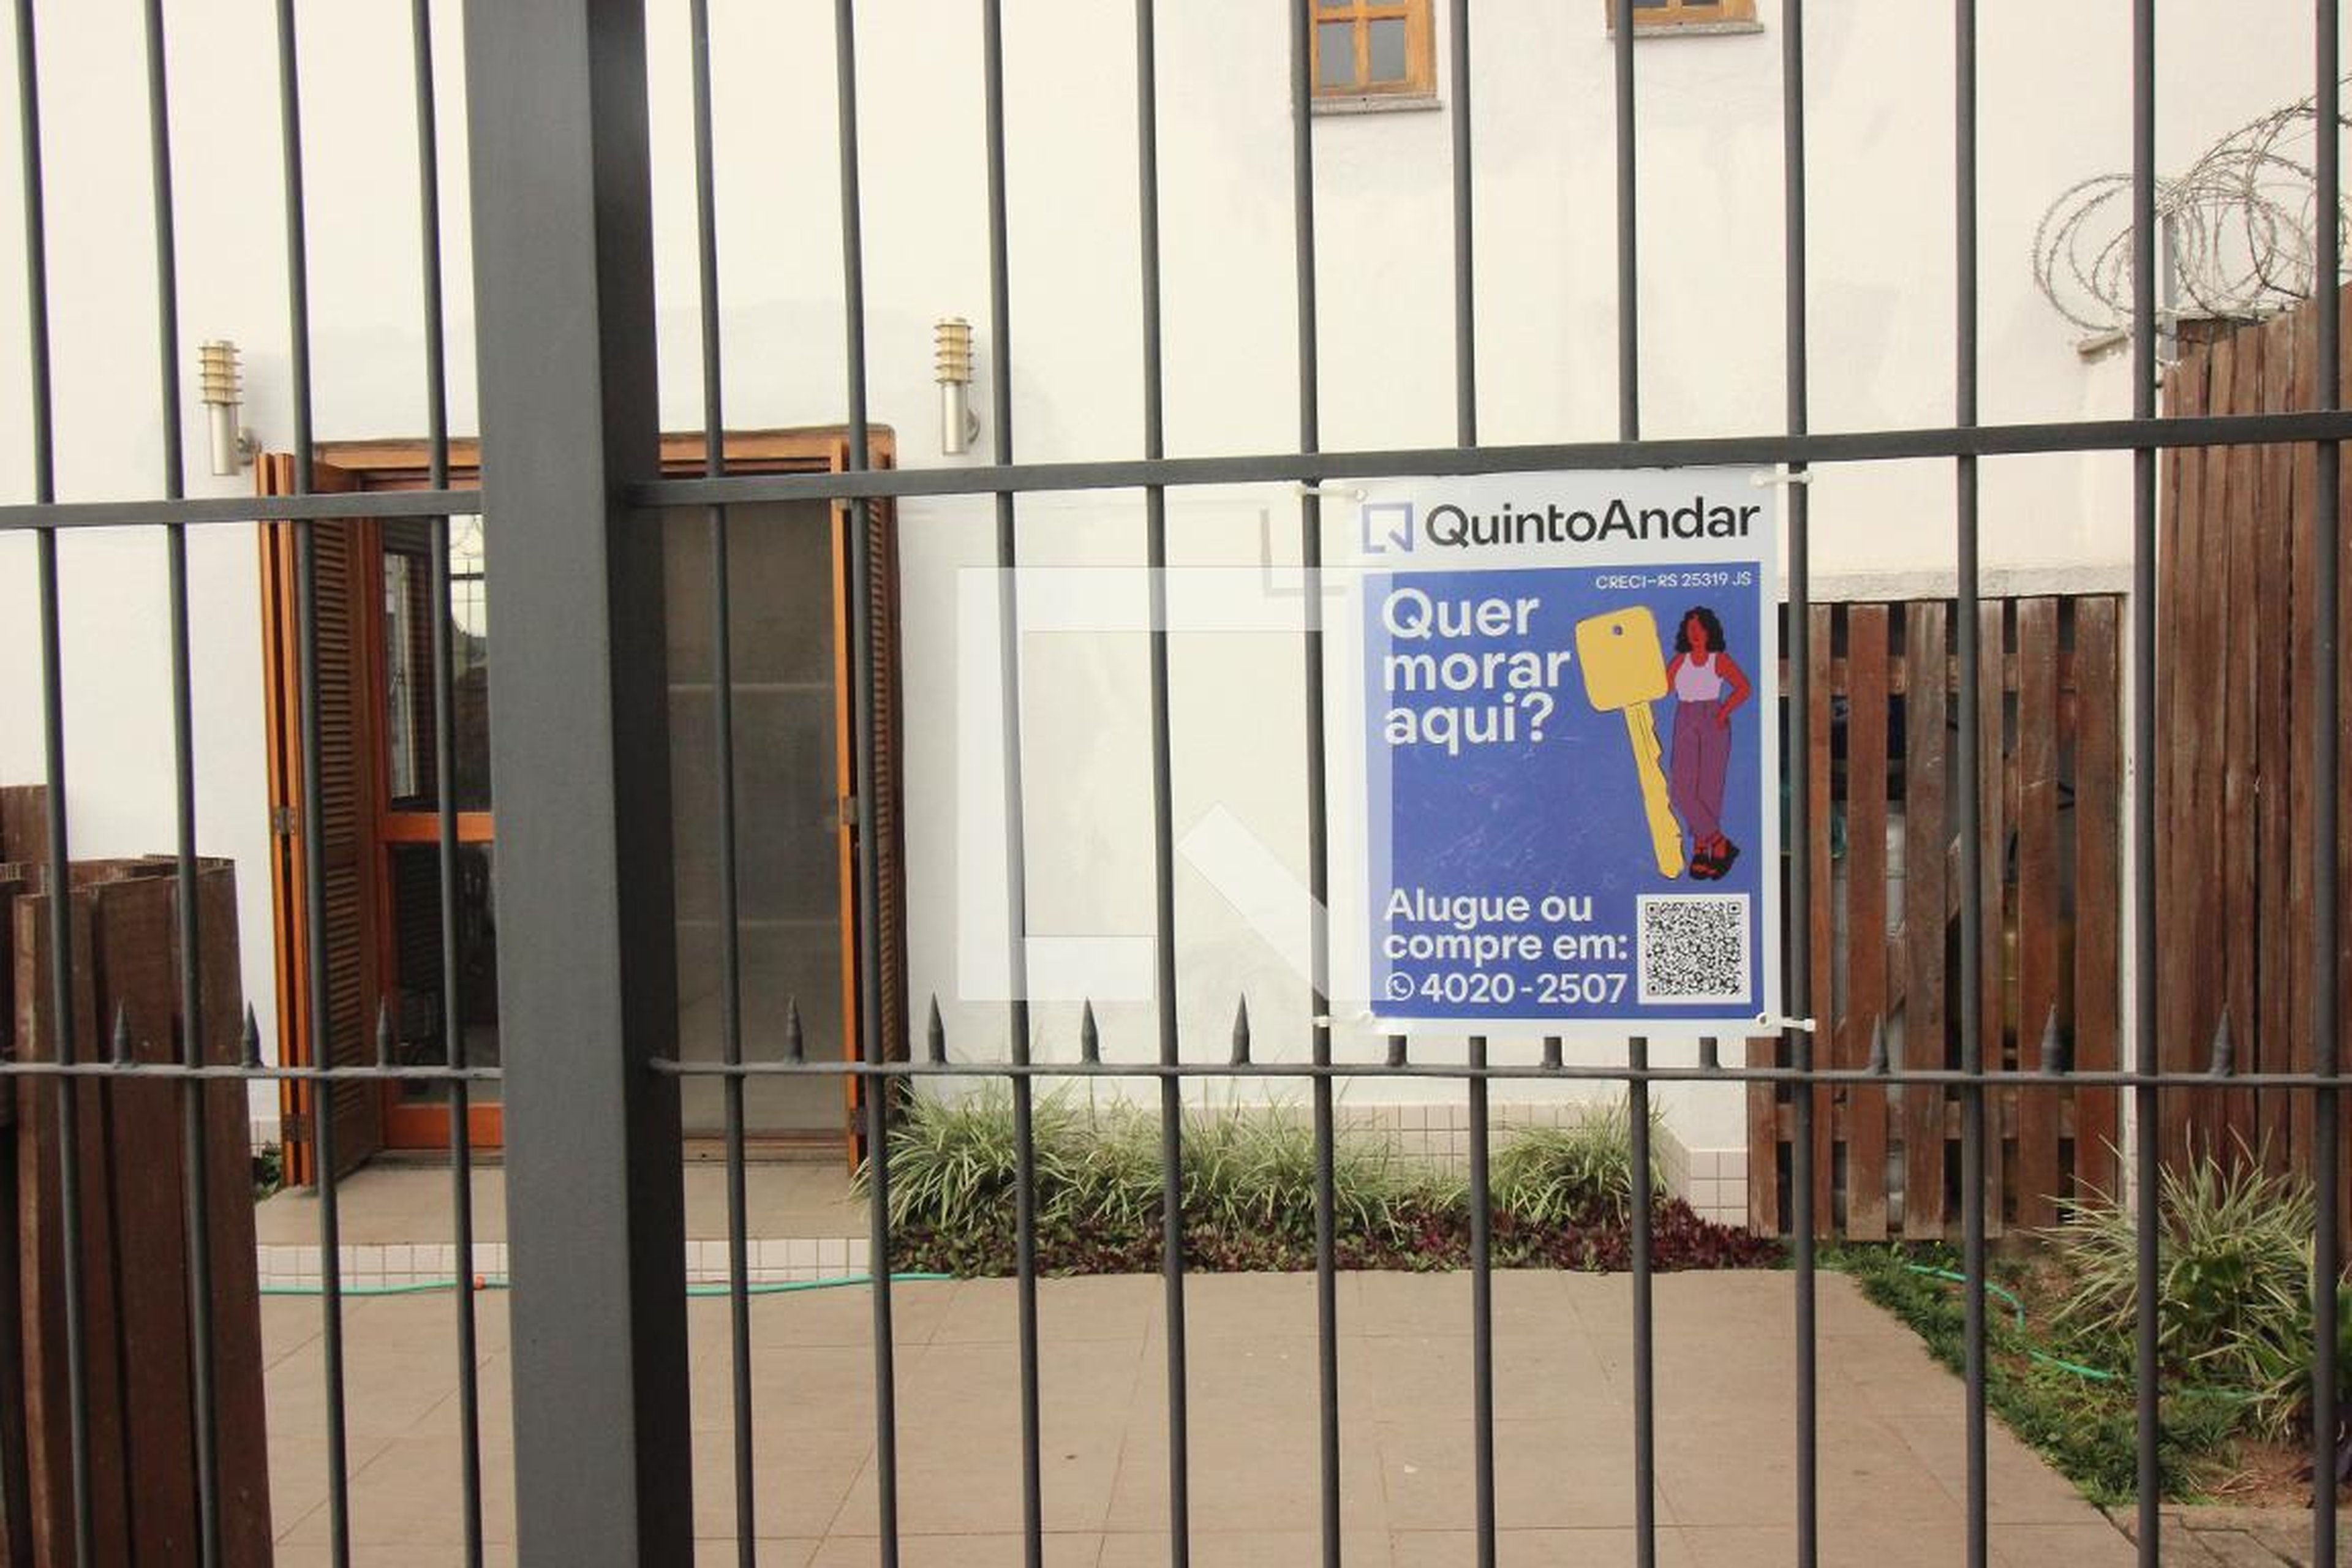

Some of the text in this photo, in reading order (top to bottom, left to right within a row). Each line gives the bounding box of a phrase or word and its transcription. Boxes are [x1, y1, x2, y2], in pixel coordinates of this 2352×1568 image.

[1426, 496, 1760, 549] QuintoAndar
[1596, 570, 1752, 589] CRECI-RS 25319 JS
[1383, 587, 1540, 639] Quer
[1384, 649, 1570, 692] morar
[1384, 692, 1555, 755] aqui?
[1384, 888, 1593, 930] Alugue ou
[1384, 933, 1628, 968] compre em:
